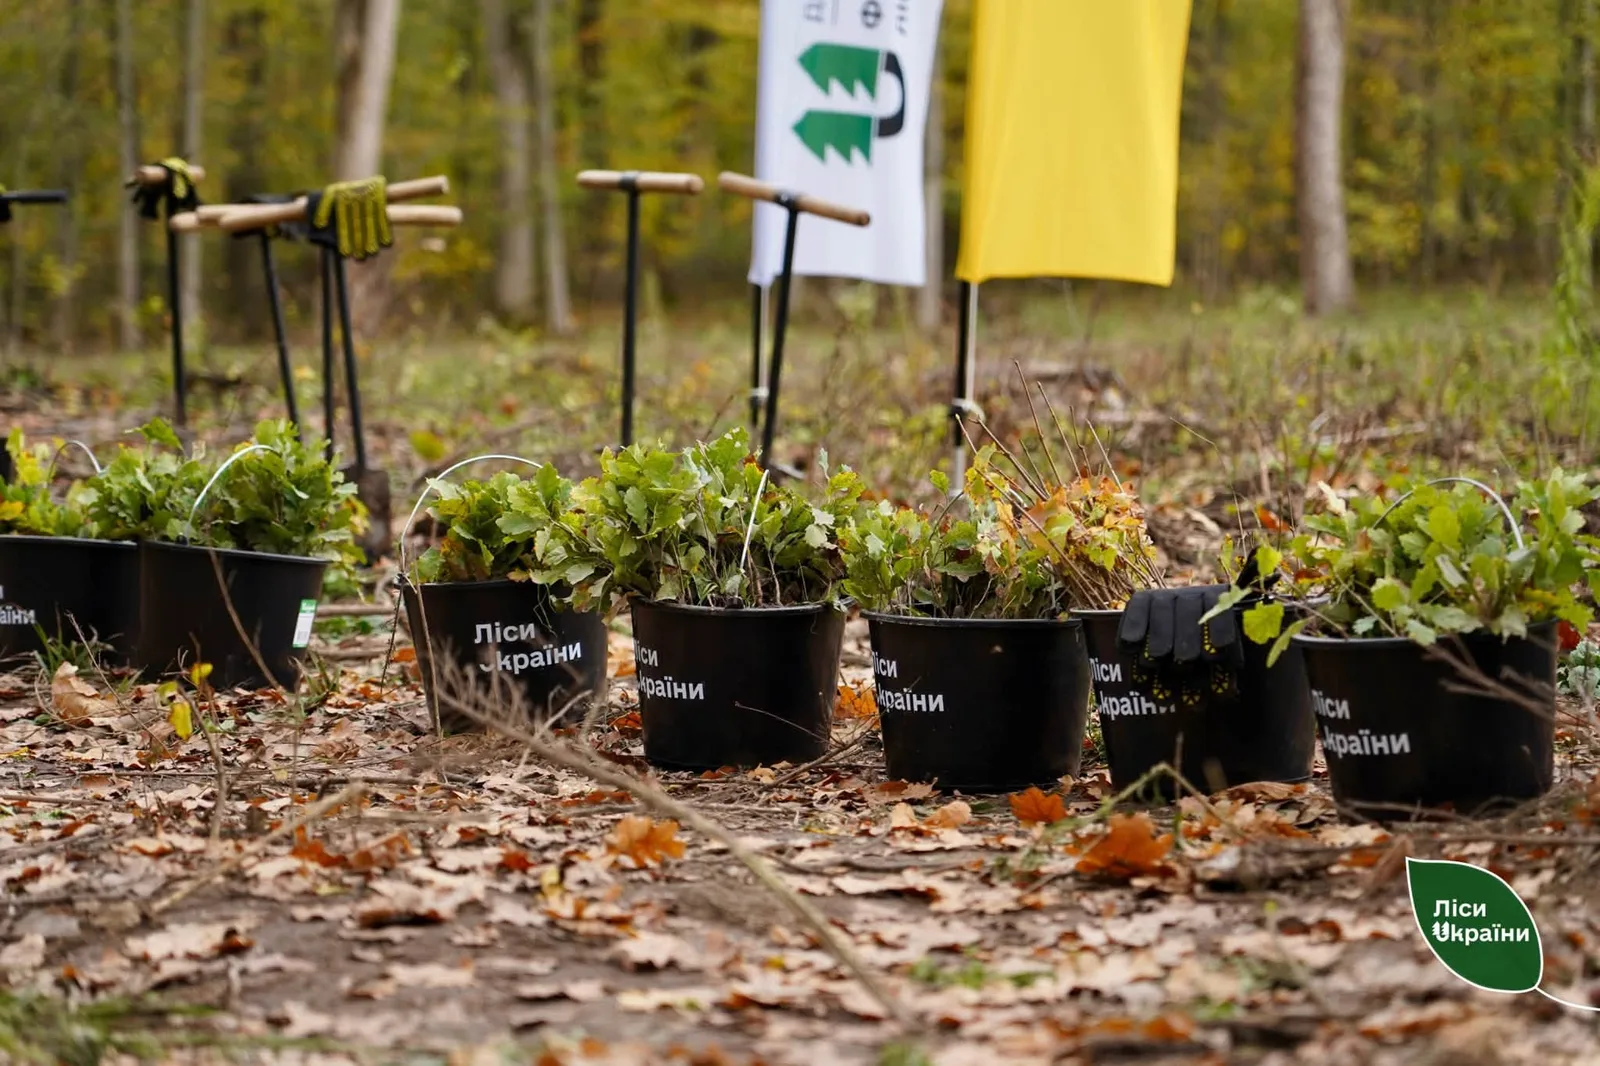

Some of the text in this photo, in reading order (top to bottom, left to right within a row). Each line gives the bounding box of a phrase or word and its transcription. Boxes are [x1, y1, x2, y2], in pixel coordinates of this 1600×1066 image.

[474, 621, 536, 644] Ліси
[479, 641, 582, 675] країни
[637, 669, 705, 700] країни
[877, 682, 945, 713] країни
[1323, 725, 1411, 758] країни
